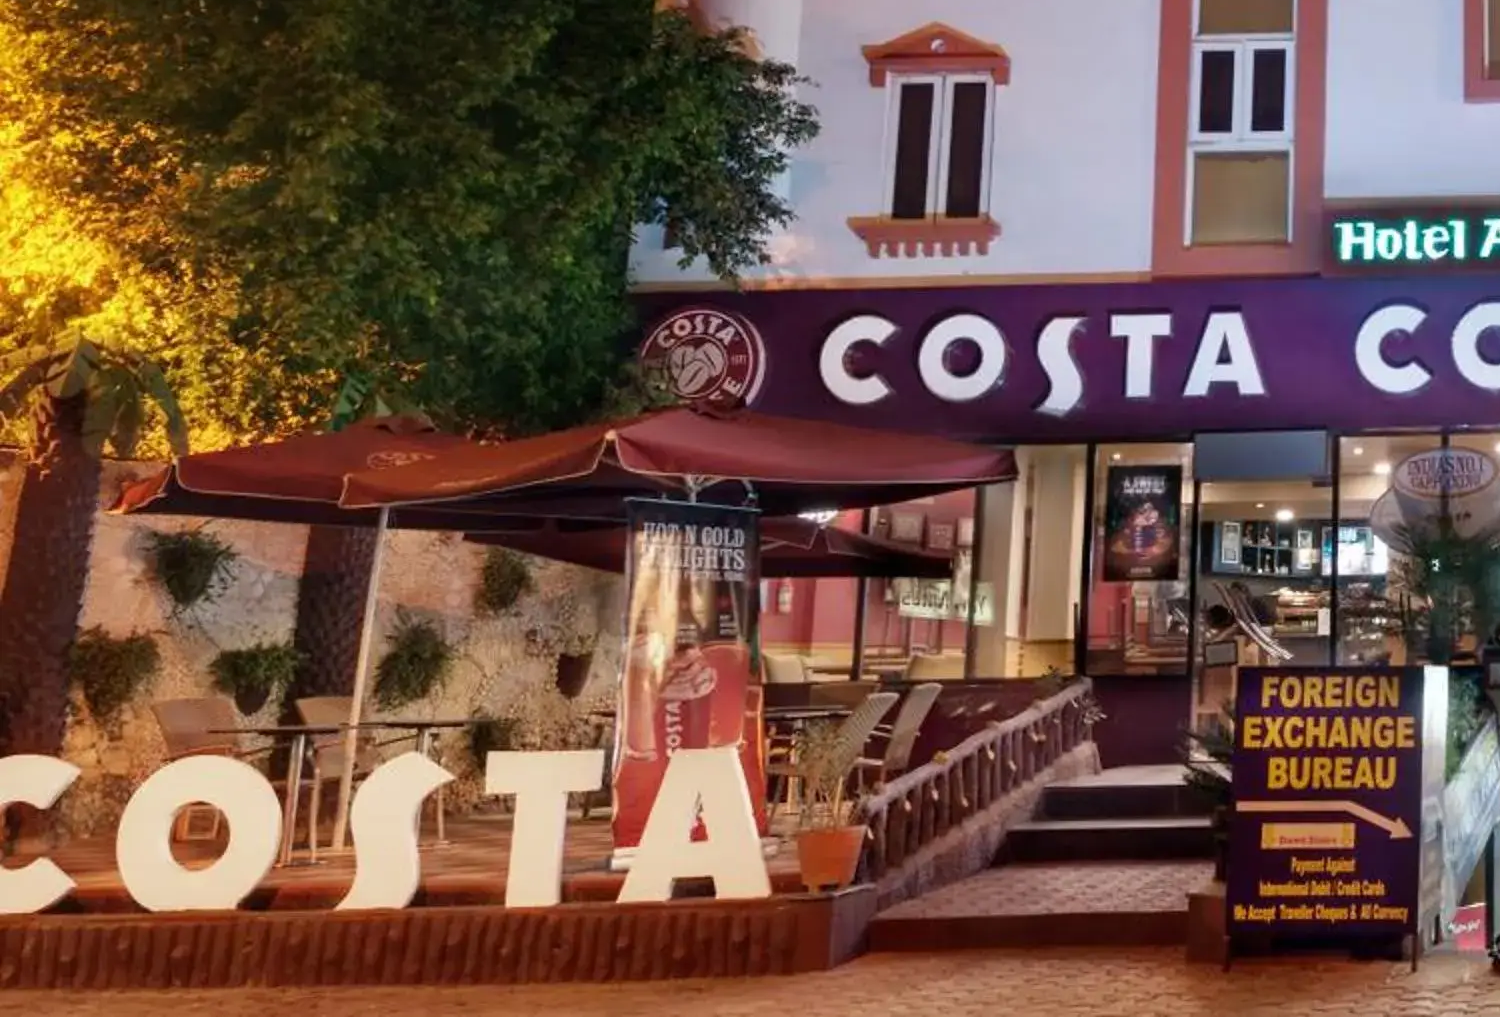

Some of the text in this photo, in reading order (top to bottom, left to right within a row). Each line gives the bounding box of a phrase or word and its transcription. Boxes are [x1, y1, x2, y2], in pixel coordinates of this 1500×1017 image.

[1334, 219, 1466, 261] Hotel
[657, 314, 737, 348] COSTA
[819, 311, 1268, 418] COSTA
[685, 524, 698, 544] N
[701, 526, 745, 547] COLD
[1261, 676, 1399, 709] FOREIGN
[1243, 716, 1415, 749] EXCHANGE
[1267, 756, 1397, 790] BUREAU
